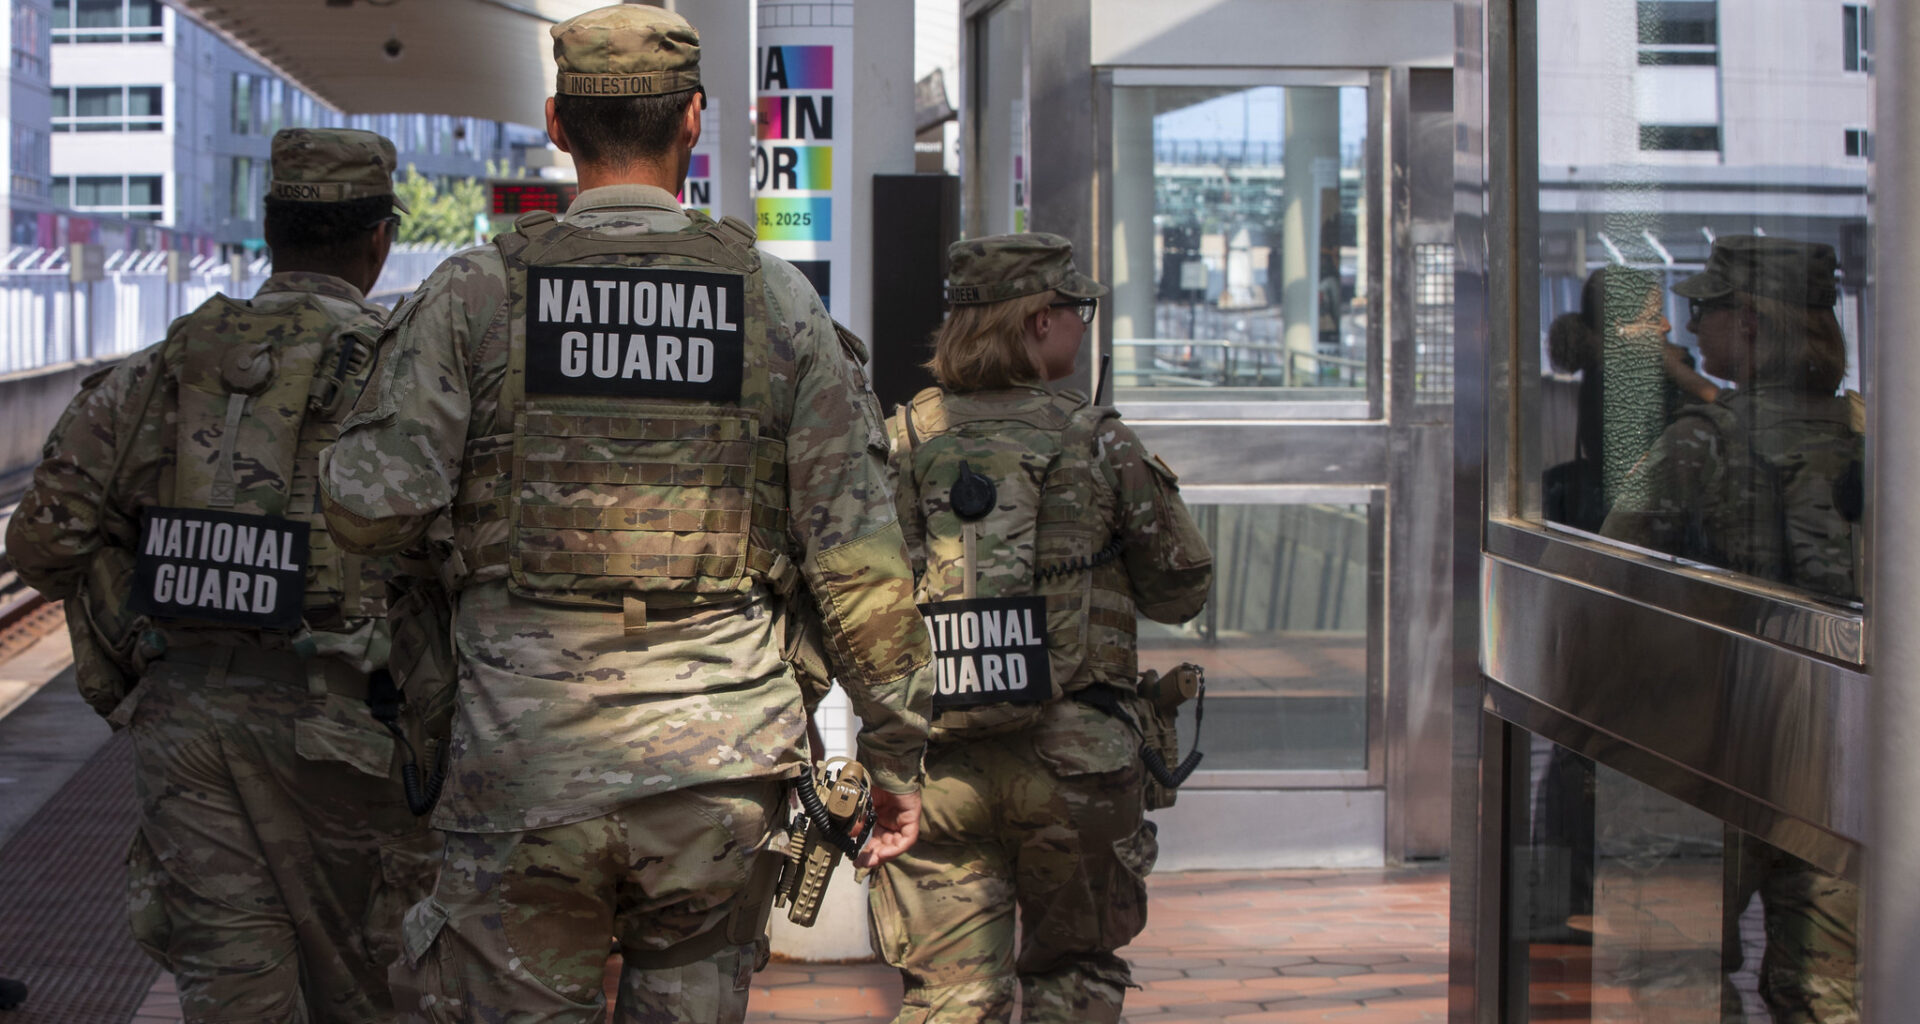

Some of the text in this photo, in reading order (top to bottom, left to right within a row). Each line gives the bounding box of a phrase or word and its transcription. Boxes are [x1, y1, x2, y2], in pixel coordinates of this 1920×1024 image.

[571, 76, 652, 94] INGLESTON
[781, 96, 833, 139] IN
[275, 184, 320, 199] HUDSON
[776, 212, 812, 227] 2025
[538, 278, 737, 332] NATIONAL
[560, 331, 714, 383] GUARD
[145, 517, 299, 572] NATIONAL
[153, 563, 278, 614] GUARD
[932, 653, 1028, 696] UARD
